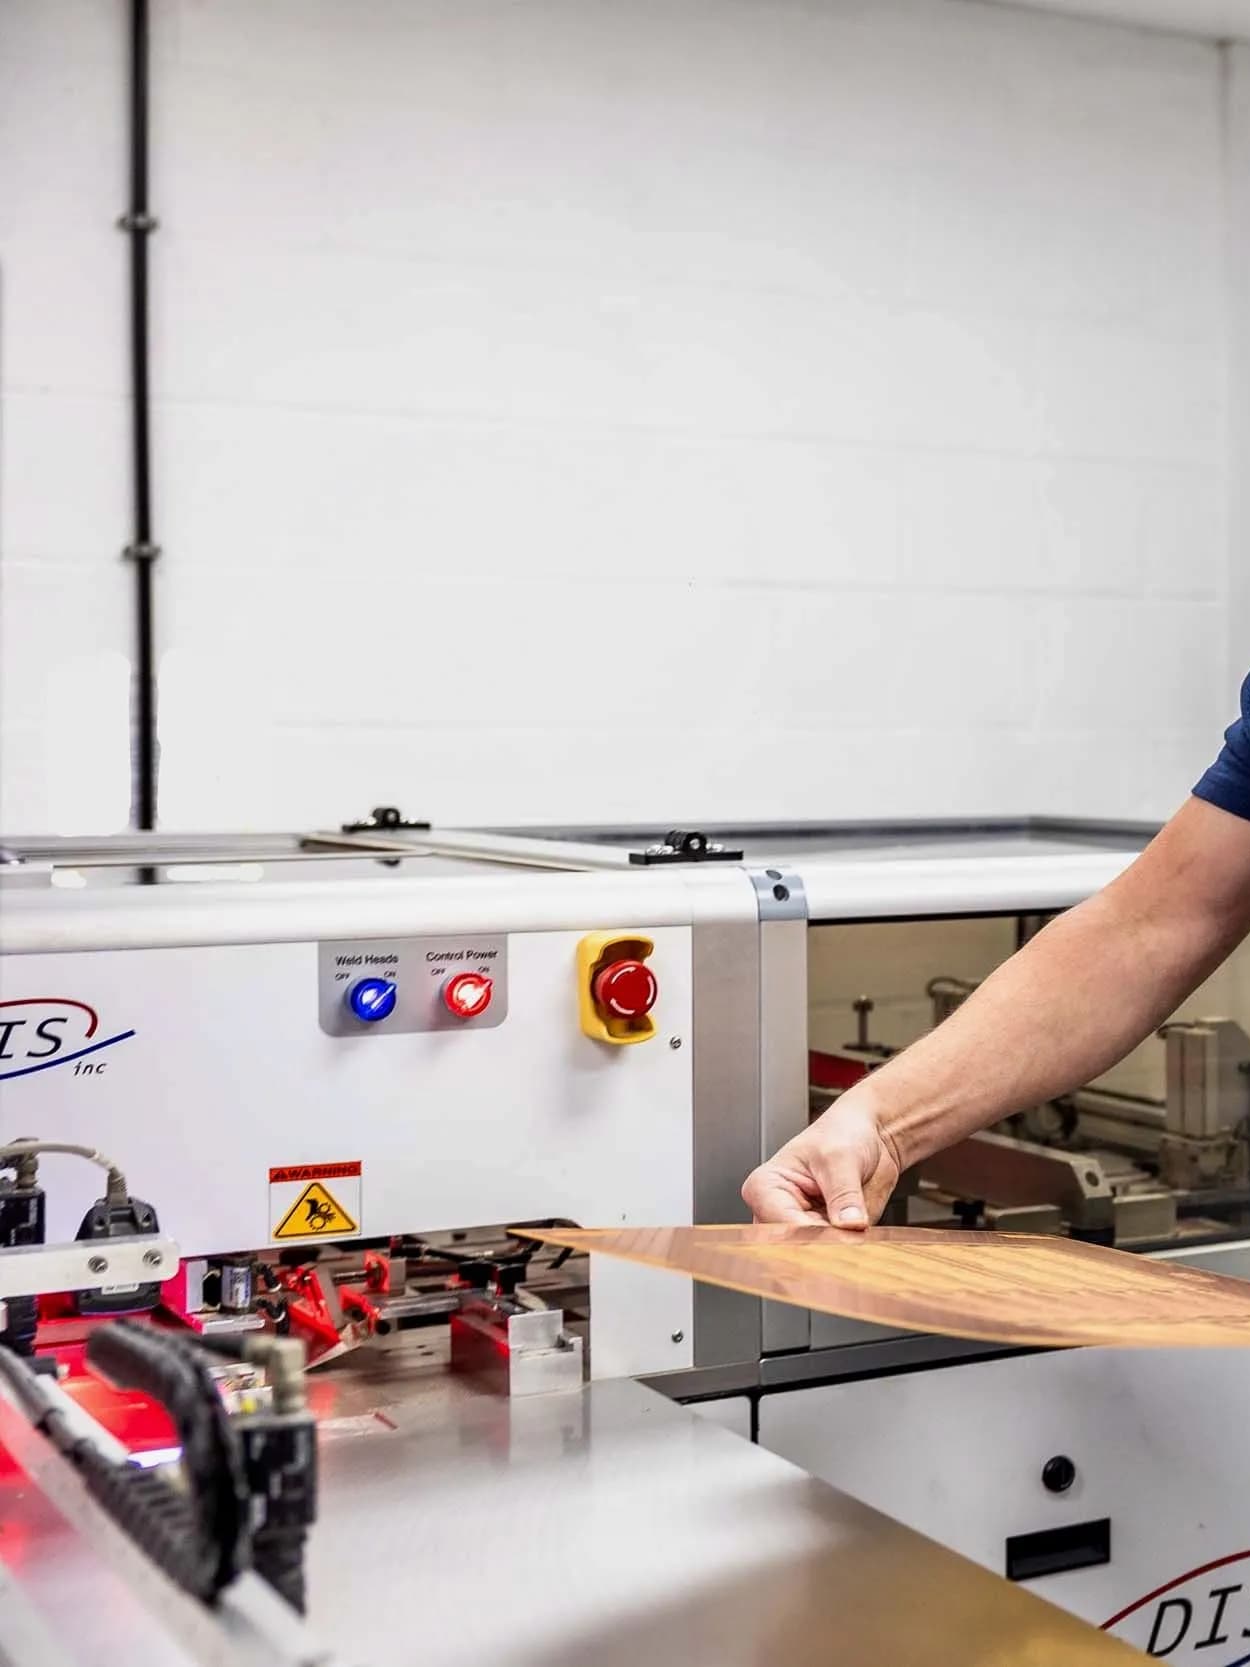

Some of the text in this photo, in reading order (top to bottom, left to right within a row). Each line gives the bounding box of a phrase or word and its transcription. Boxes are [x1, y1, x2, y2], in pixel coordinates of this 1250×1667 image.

[335, 953, 399, 966] Weld Heads
[426, 950, 498, 962] Control Power
[0, 1017, 68, 1059] IS
[73, 1061, 107, 1076] inc
[287, 1165, 358, 1178] WARNING
